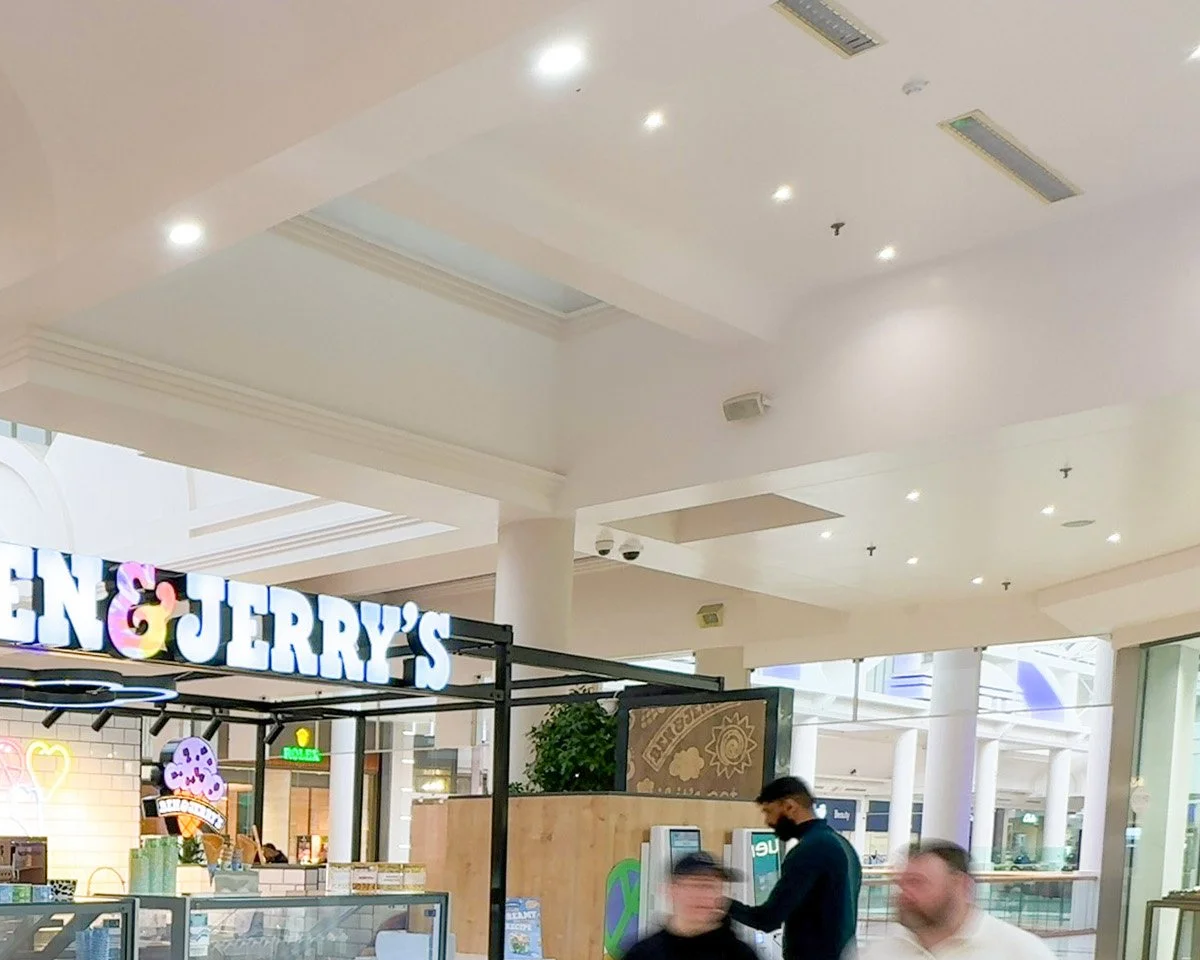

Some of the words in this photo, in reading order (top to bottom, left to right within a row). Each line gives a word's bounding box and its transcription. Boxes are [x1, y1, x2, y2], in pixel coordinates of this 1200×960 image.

[176, 573, 450, 691] JERRY'S
[283, 746, 321, 762] ROLEX
[505, 911, 538, 920] REAMY
